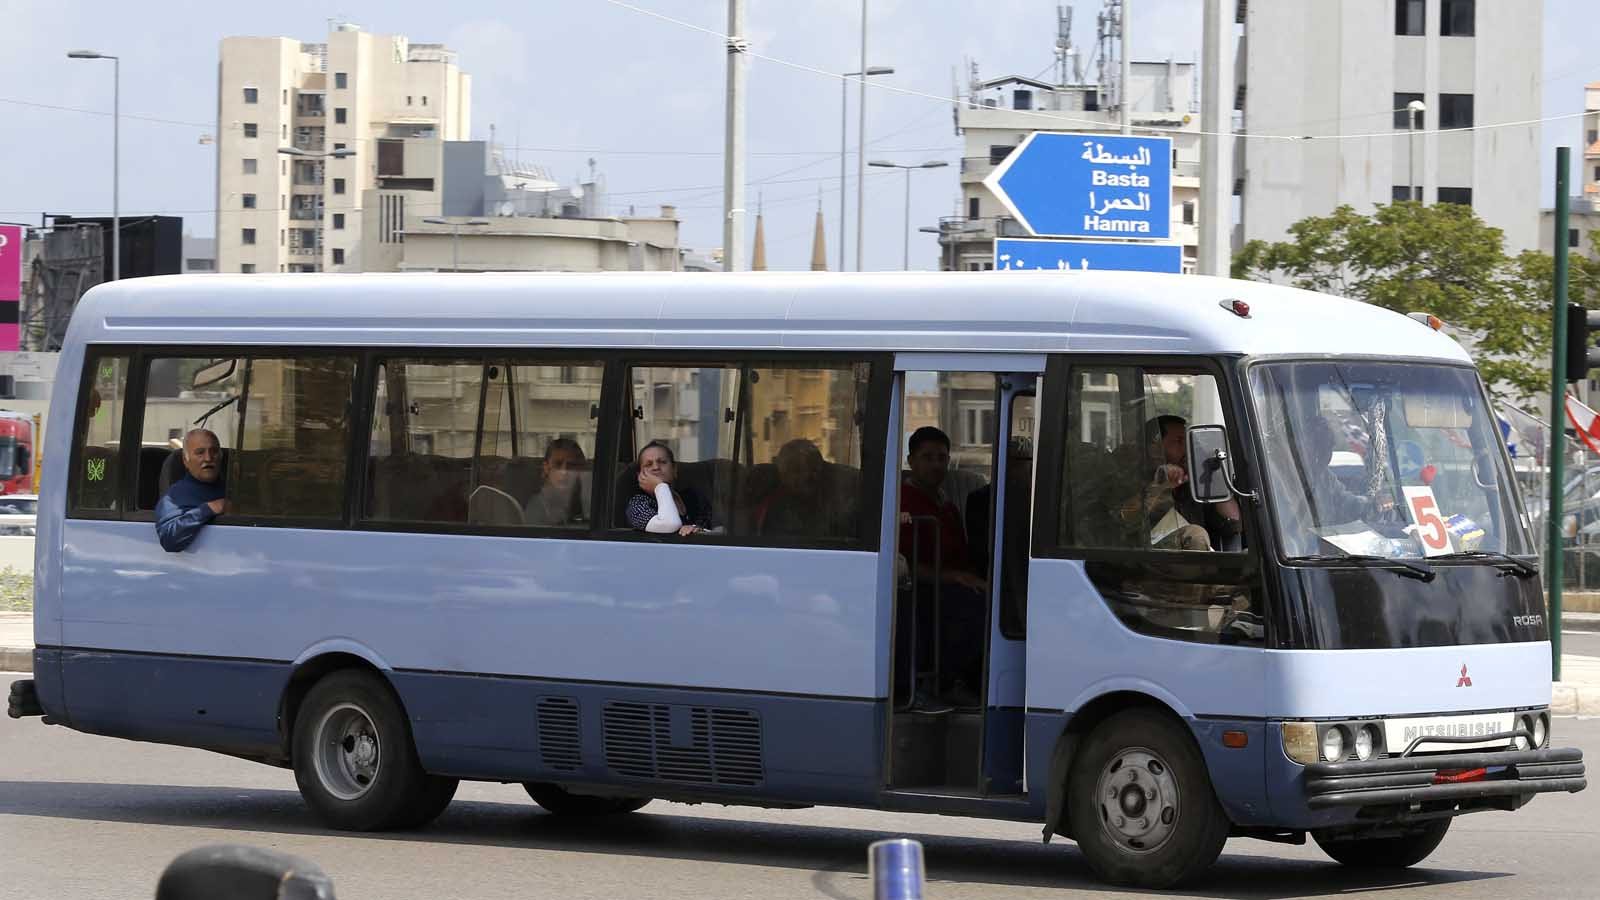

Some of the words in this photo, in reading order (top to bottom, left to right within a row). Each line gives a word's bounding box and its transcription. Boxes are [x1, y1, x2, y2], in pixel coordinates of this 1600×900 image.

[1081, 142, 1151, 169] البسطة
[1092, 170, 1150, 187] Basta
[1089, 191, 1150, 214] الحمرا
[1084, 215, 1150, 232] Hamra
[1411, 496, 1447, 549] 5
[1513, 614, 1543, 626] ROSA
